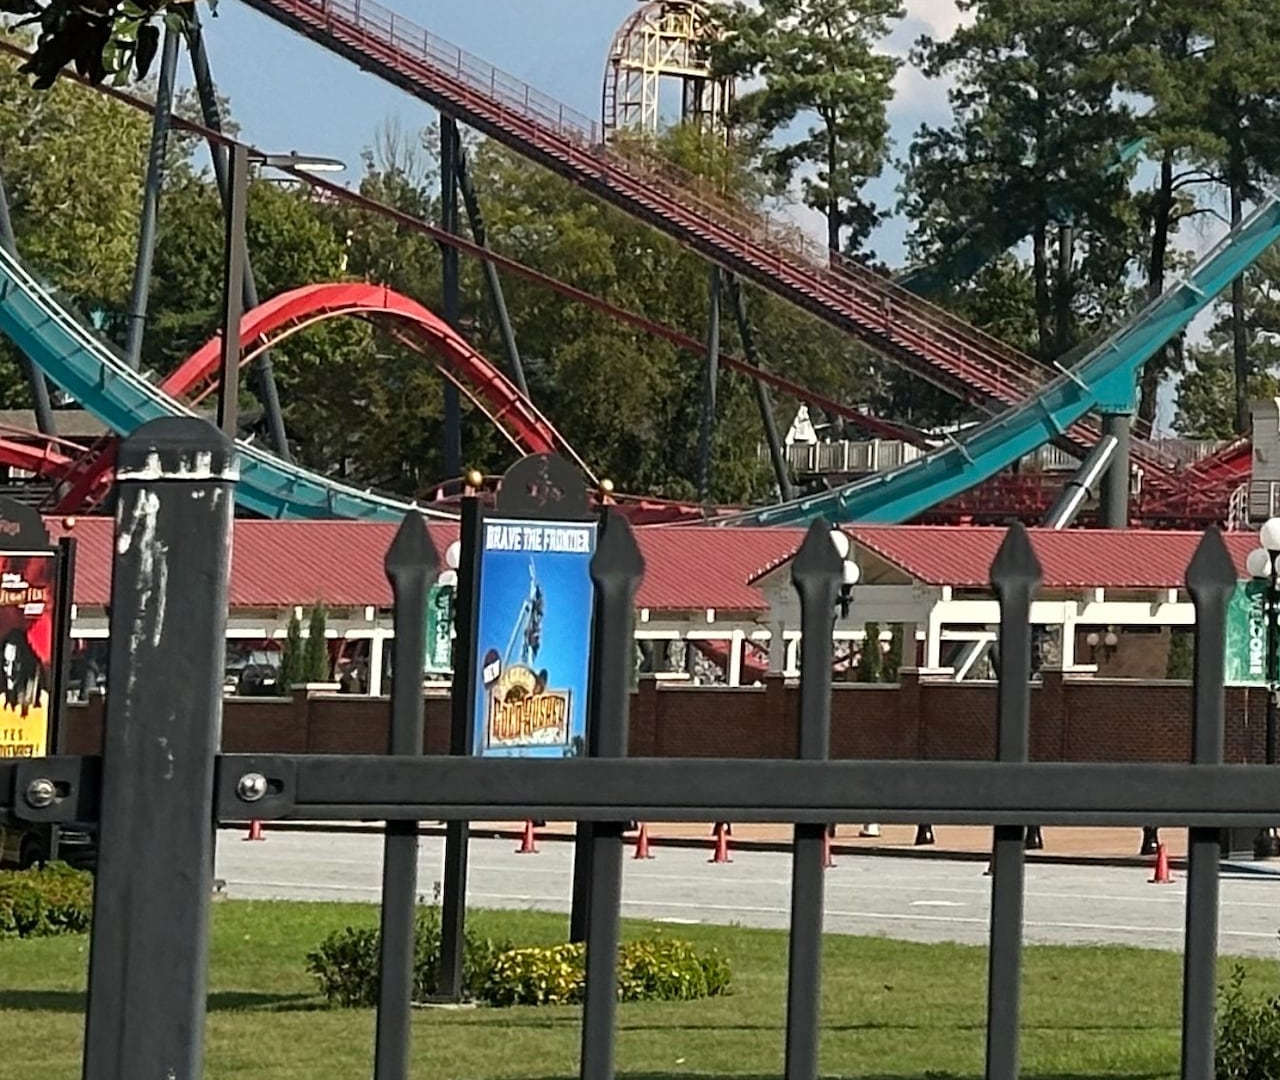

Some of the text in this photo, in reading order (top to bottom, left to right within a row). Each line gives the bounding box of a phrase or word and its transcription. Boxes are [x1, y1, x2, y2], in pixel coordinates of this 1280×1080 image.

[486, 525, 590, 553] BRAVE THE FRONTIER
[1249, 592, 1263, 674] WELCOME
